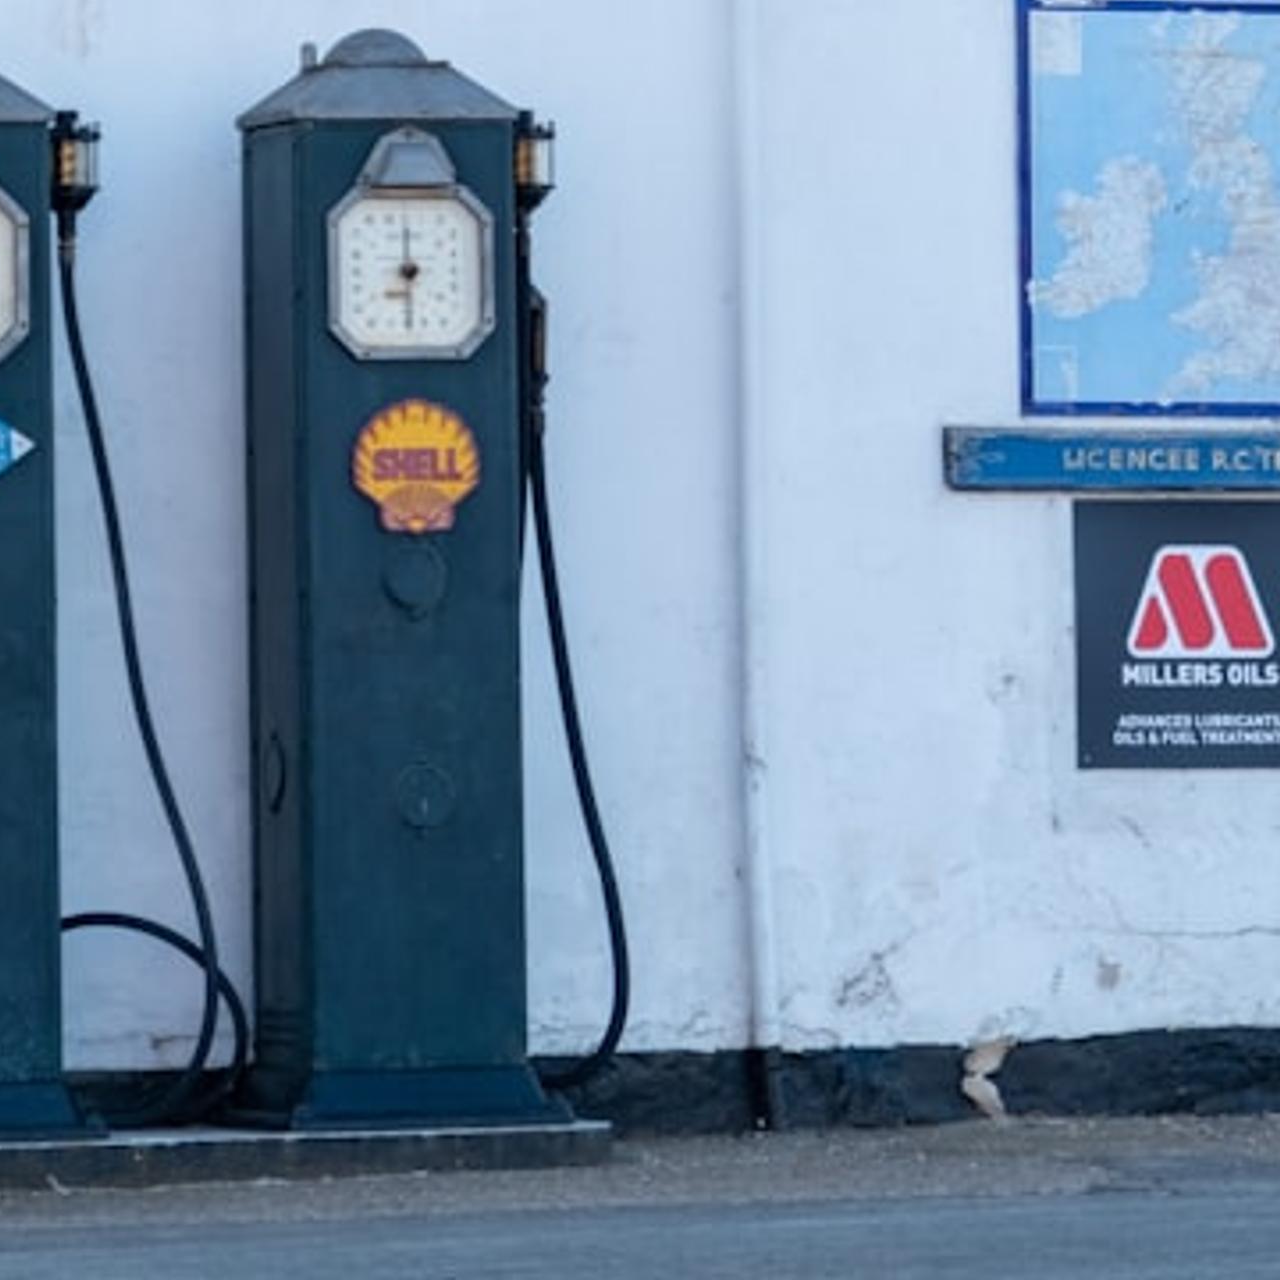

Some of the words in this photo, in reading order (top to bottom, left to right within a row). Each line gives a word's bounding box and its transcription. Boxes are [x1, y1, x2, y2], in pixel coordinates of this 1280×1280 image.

[372, 448, 462, 481] SHELL
[1062, 447, 1200, 471] LICENCEE
[1122, 663, 1223, 686] MILLERS
[1227, 663, 1280, 686] OILS
[1113, 731, 1144, 745] OILS
[1163, 731, 1197, 745] FUEL
